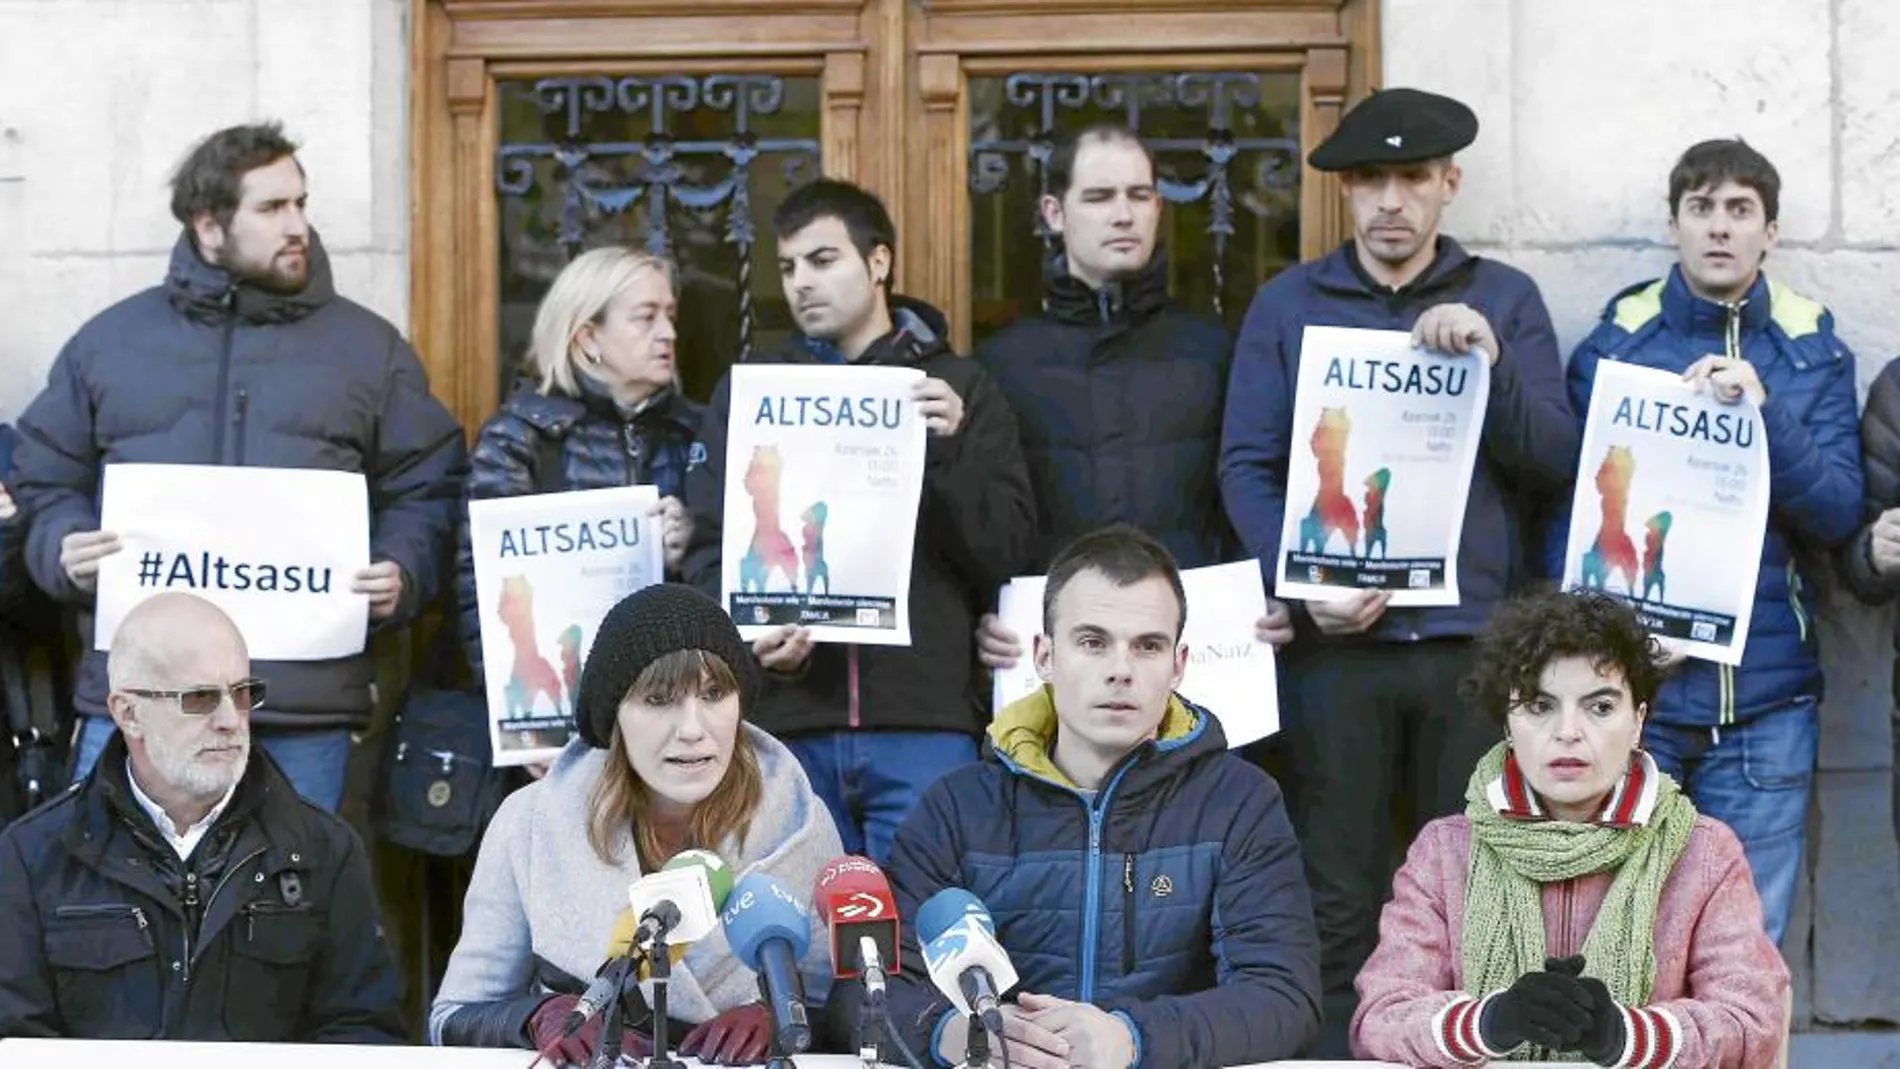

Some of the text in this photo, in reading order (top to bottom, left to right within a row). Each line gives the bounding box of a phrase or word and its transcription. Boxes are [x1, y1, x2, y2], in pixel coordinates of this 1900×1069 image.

[1323, 356, 1468, 397] ALTSASU
[754, 395, 901, 429] ALTSASU
[1612, 396, 1753, 449] ALTSASU
[500, 517, 640, 558] ALTSASU
[138, 550, 332, 594] #Altsasu
